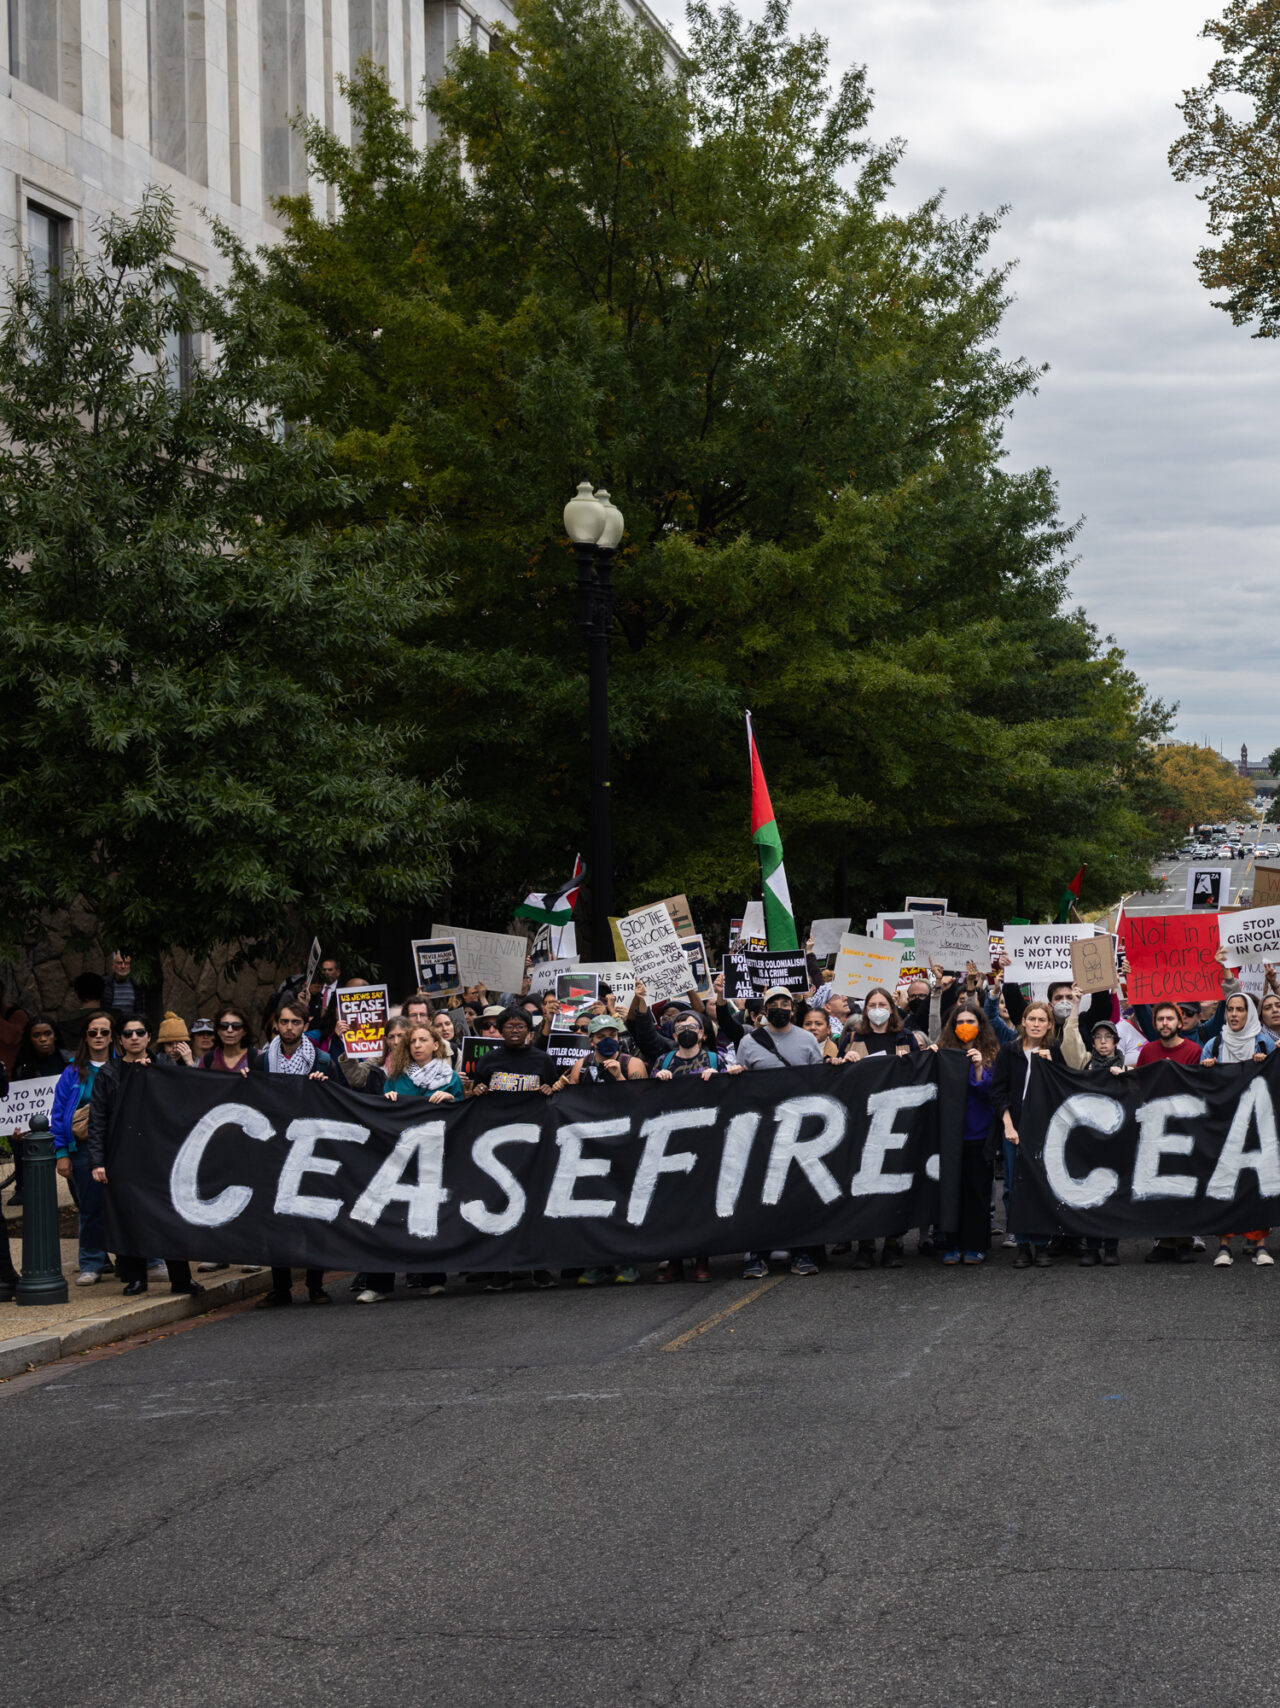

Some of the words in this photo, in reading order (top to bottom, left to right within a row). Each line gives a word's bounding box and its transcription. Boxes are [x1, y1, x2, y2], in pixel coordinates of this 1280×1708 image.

[620, 915, 647, 938] STOP
[645, 909, 667, 927] THE
[1243, 918, 1275, 931] STOP
[625, 923, 675, 952] GENOCIDE
[1130, 916, 1171, 949] Not
[1183, 922, 1199, 943] in
[1024, 935, 1041, 945] MY
[1044, 935, 1078, 945] GRIEF
[659, 941, 681, 956] ISRAEL
[1014, 948, 1024, 958] IS
[1028, 948, 1052, 958] NOT
[1236, 945, 1249, 955] IN
[667, 951, 685, 963] USA
[765, 958, 806, 969] COLONIALISM
[1025, 961, 1072, 970] WEAPO
[615, 972, 636, 981] SAY
[640, 962, 688, 987] PALESTINIAN
[769, 968, 789, 977] CRIME
[771, 976, 803, 987] HUMANITY
[351, 992, 371, 1001] JEWS
[371, 991, 384, 999] SAY
[649, 988, 672, 1001] YOUR
[737, 989, 754, 998] ARE
[341, 999, 386, 1013] CEASE
[346, 1010, 383, 1025] FIRE
[344, 1027, 385, 1042] GAZA
[351, 1040, 384, 1052] NOW!
[556, 1057, 562, 1065] IS
[14, 1090, 29, 1100] TO
[34, 1086, 55, 1097] WA
[7, 1102, 25, 1113] NO
[29, 1099, 45, 1110] TO
[169, 1082, 941, 1239] CEASEFIRE.
